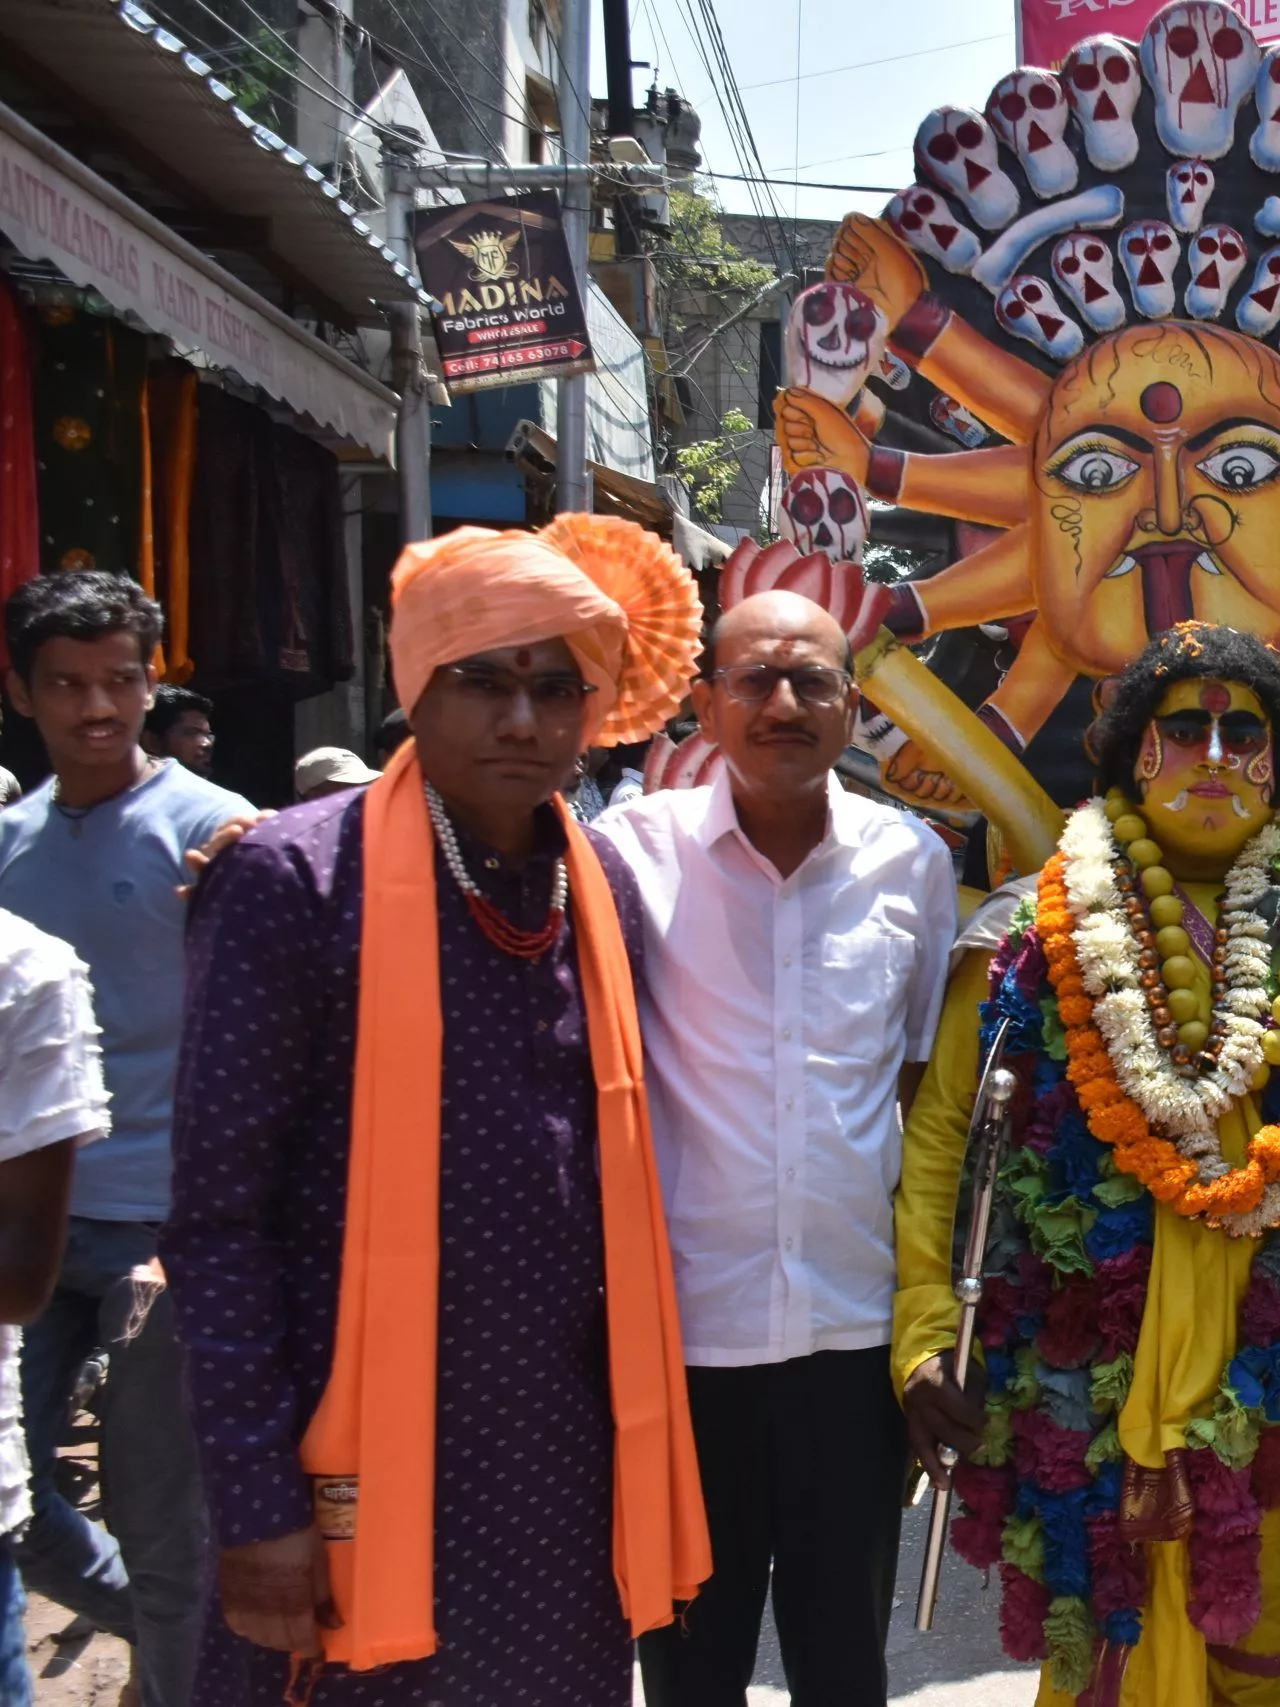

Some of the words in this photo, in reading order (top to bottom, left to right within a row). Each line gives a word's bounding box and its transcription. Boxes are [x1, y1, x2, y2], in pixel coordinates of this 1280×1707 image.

[152, 261, 202, 334] NAND
[431, 275, 569, 318] MADINA
[443, 313, 509, 333] Fabrics
[514, 303, 566, 322] World
[476, 325, 540, 341] WHOLESALE
[449, 360, 479, 374] Cell:
[528, 345, 569, 361] 63078
